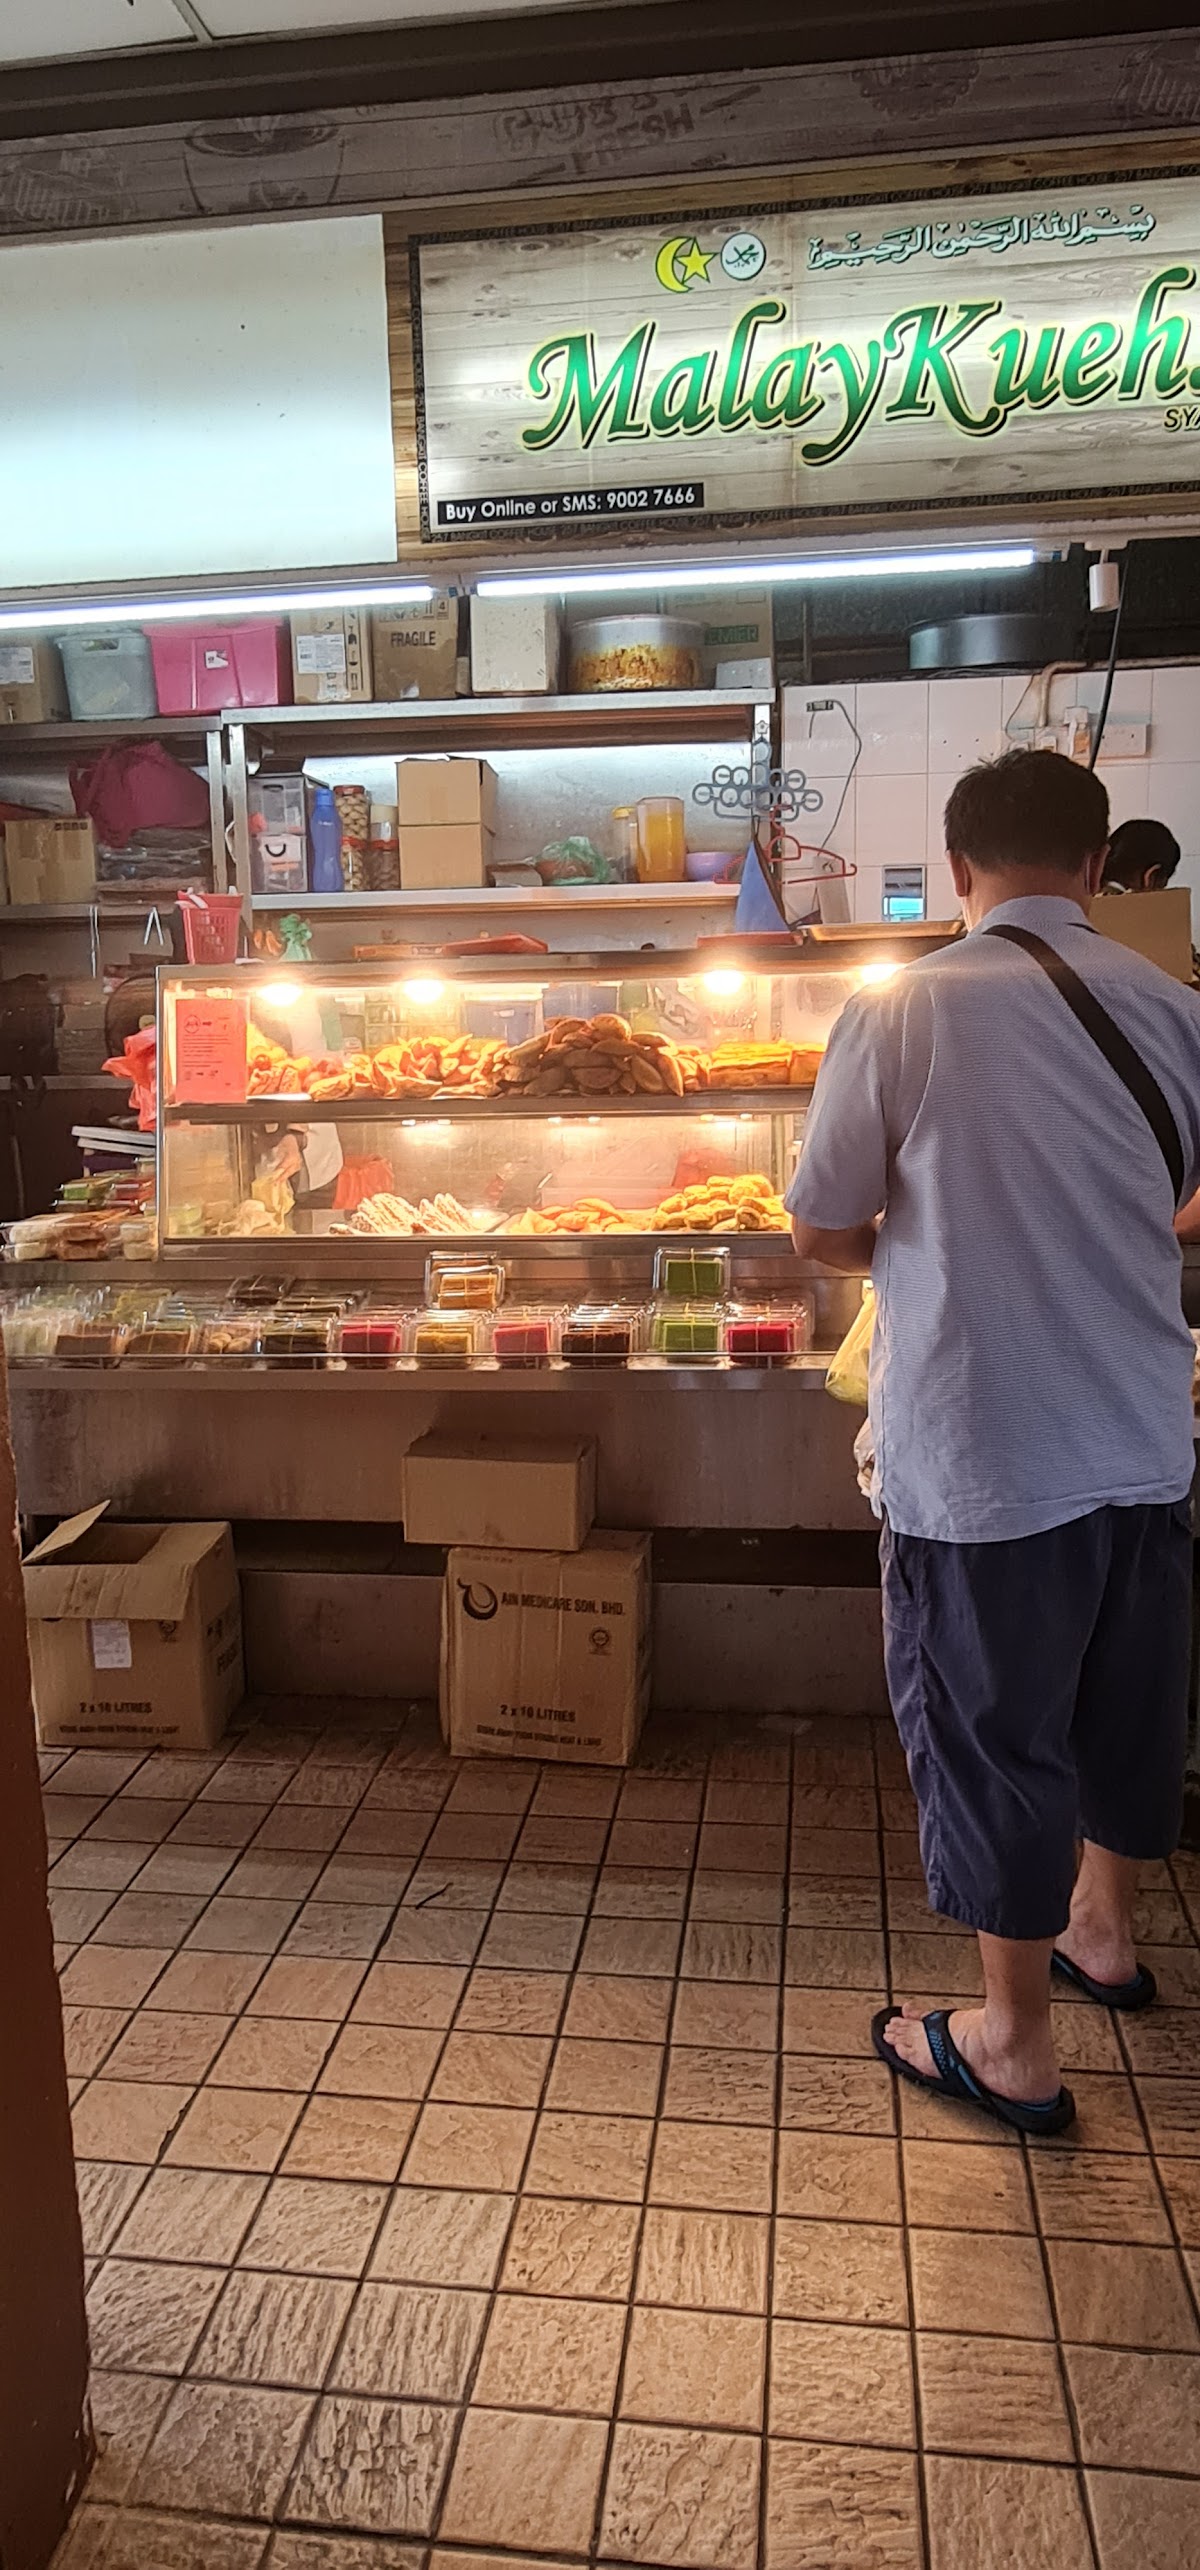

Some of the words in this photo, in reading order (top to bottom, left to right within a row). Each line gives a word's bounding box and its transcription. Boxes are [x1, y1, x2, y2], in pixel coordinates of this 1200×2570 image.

[446, 504, 476, 522] Buy
[481, 500, 536, 518] Online
[541, 501, 557, 514] or
[563, 495, 601, 513] SMS:
[606, 490, 649, 509] 9002
[653, 487, 695, 506] 7666
[390, 630, 436, 648] FRAGILE
[521, 1594, 572, 1611] MEDICARE
[80, 1702, 87, 1713] 2
[114, 1701, 153, 1713] LITRES
[500, 1704, 508, 1715] 2
[510, 1707, 518, 1717] x
[520, 1706, 535, 1718] 10
[536, 1707, 577, 1722] LITRES
